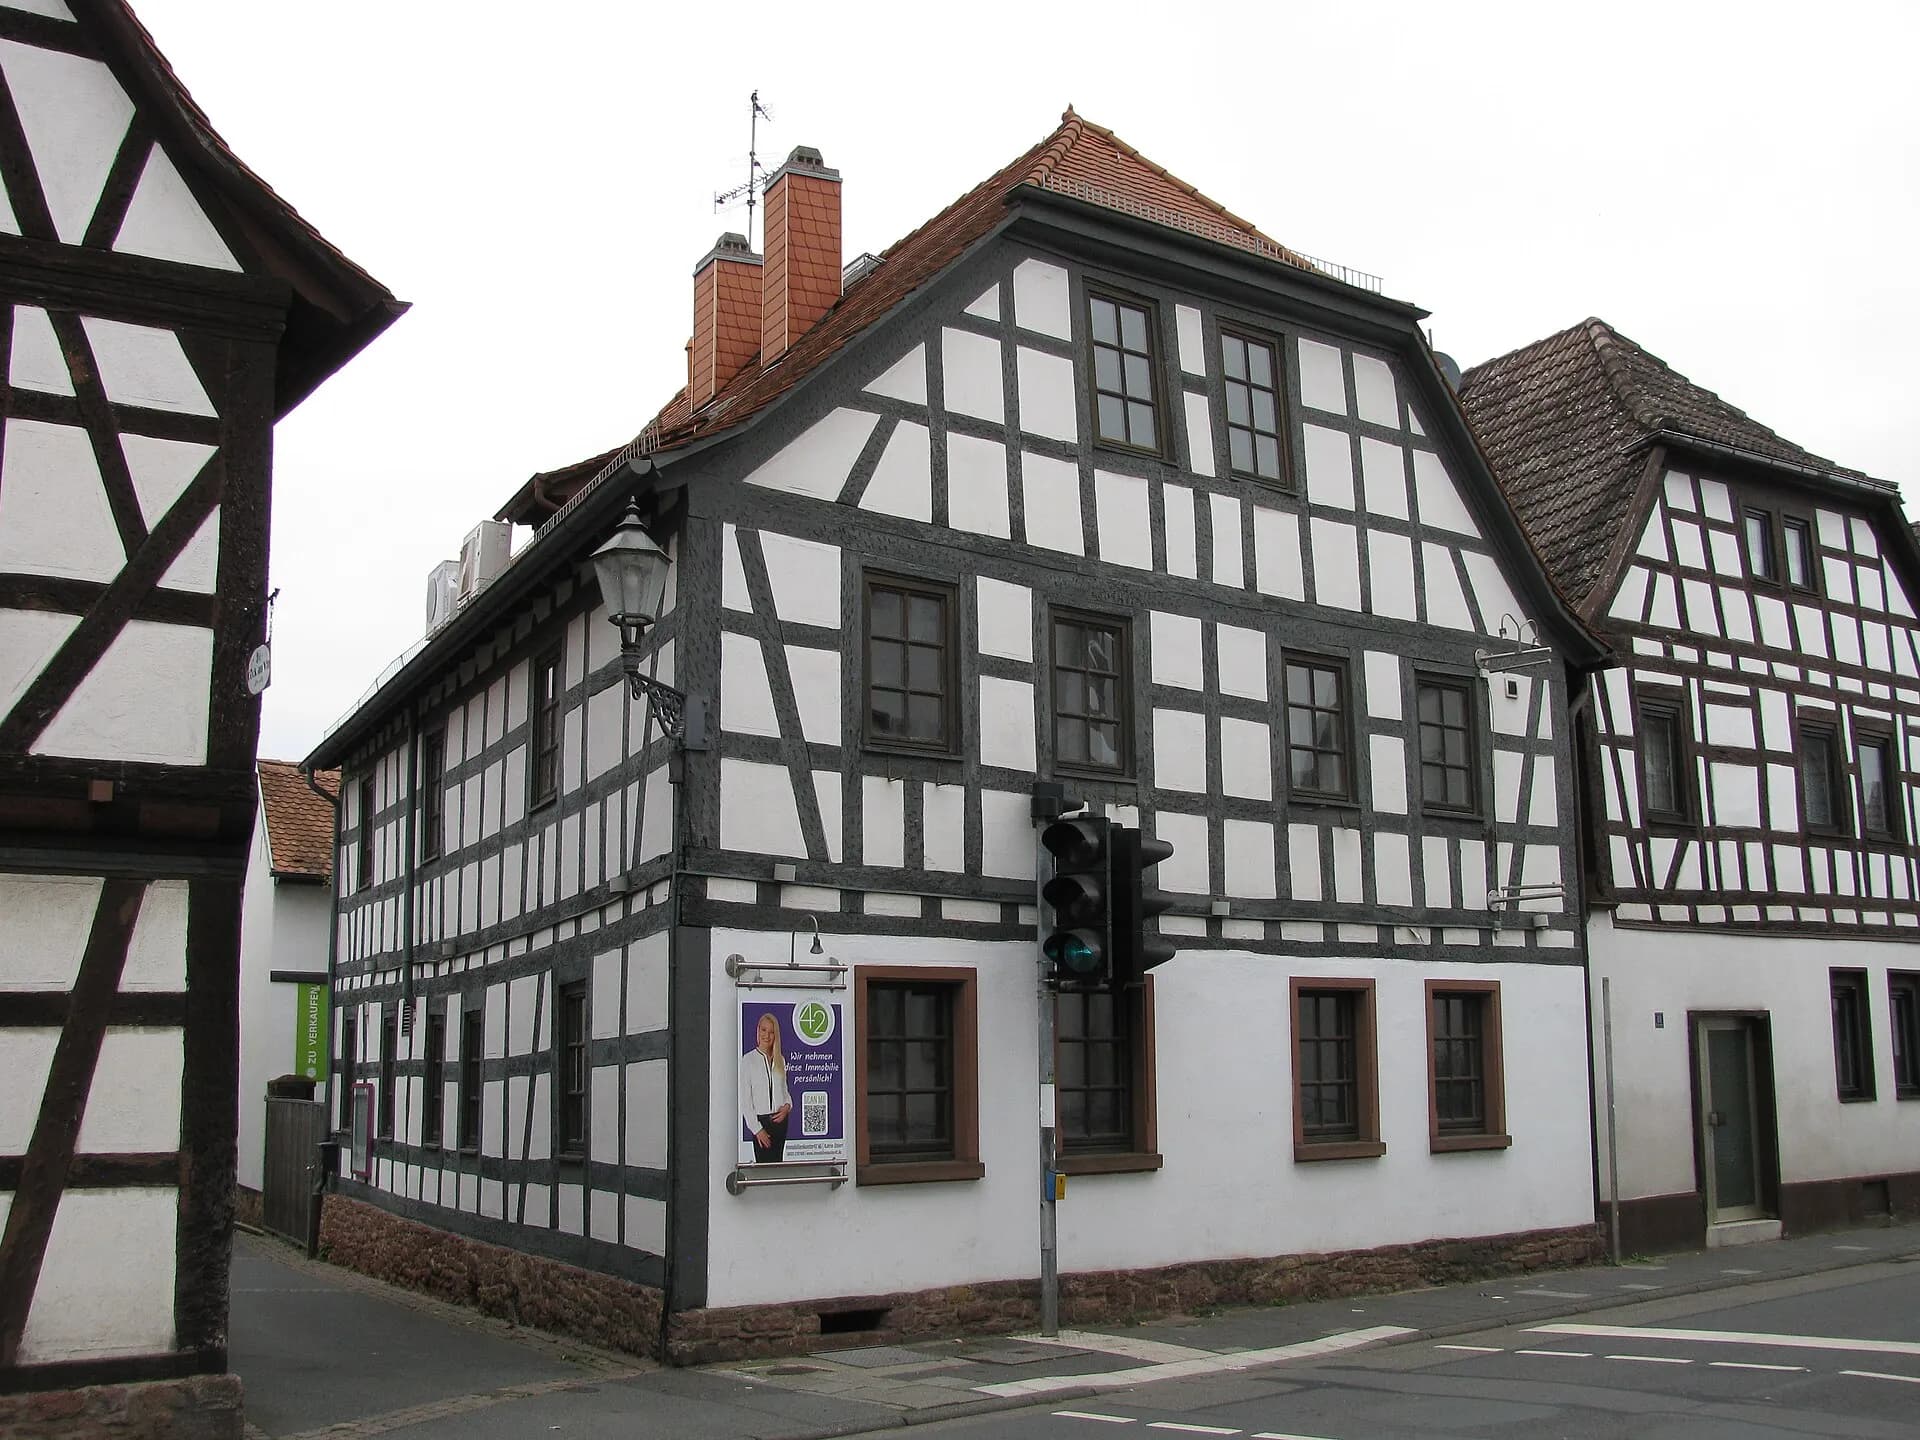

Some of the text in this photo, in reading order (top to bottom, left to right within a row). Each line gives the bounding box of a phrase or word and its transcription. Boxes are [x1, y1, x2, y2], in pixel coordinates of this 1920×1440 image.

[800, 1003, 826, 1034] 42
[308, 987, 319, 1064] ZU VERKAUFEN
[791, 1051, 832, 1060] Wir nehmen
[784, 1063, 839, 1072] diese Immobilie
[794, 1074, 833, 1085] persönlich!
